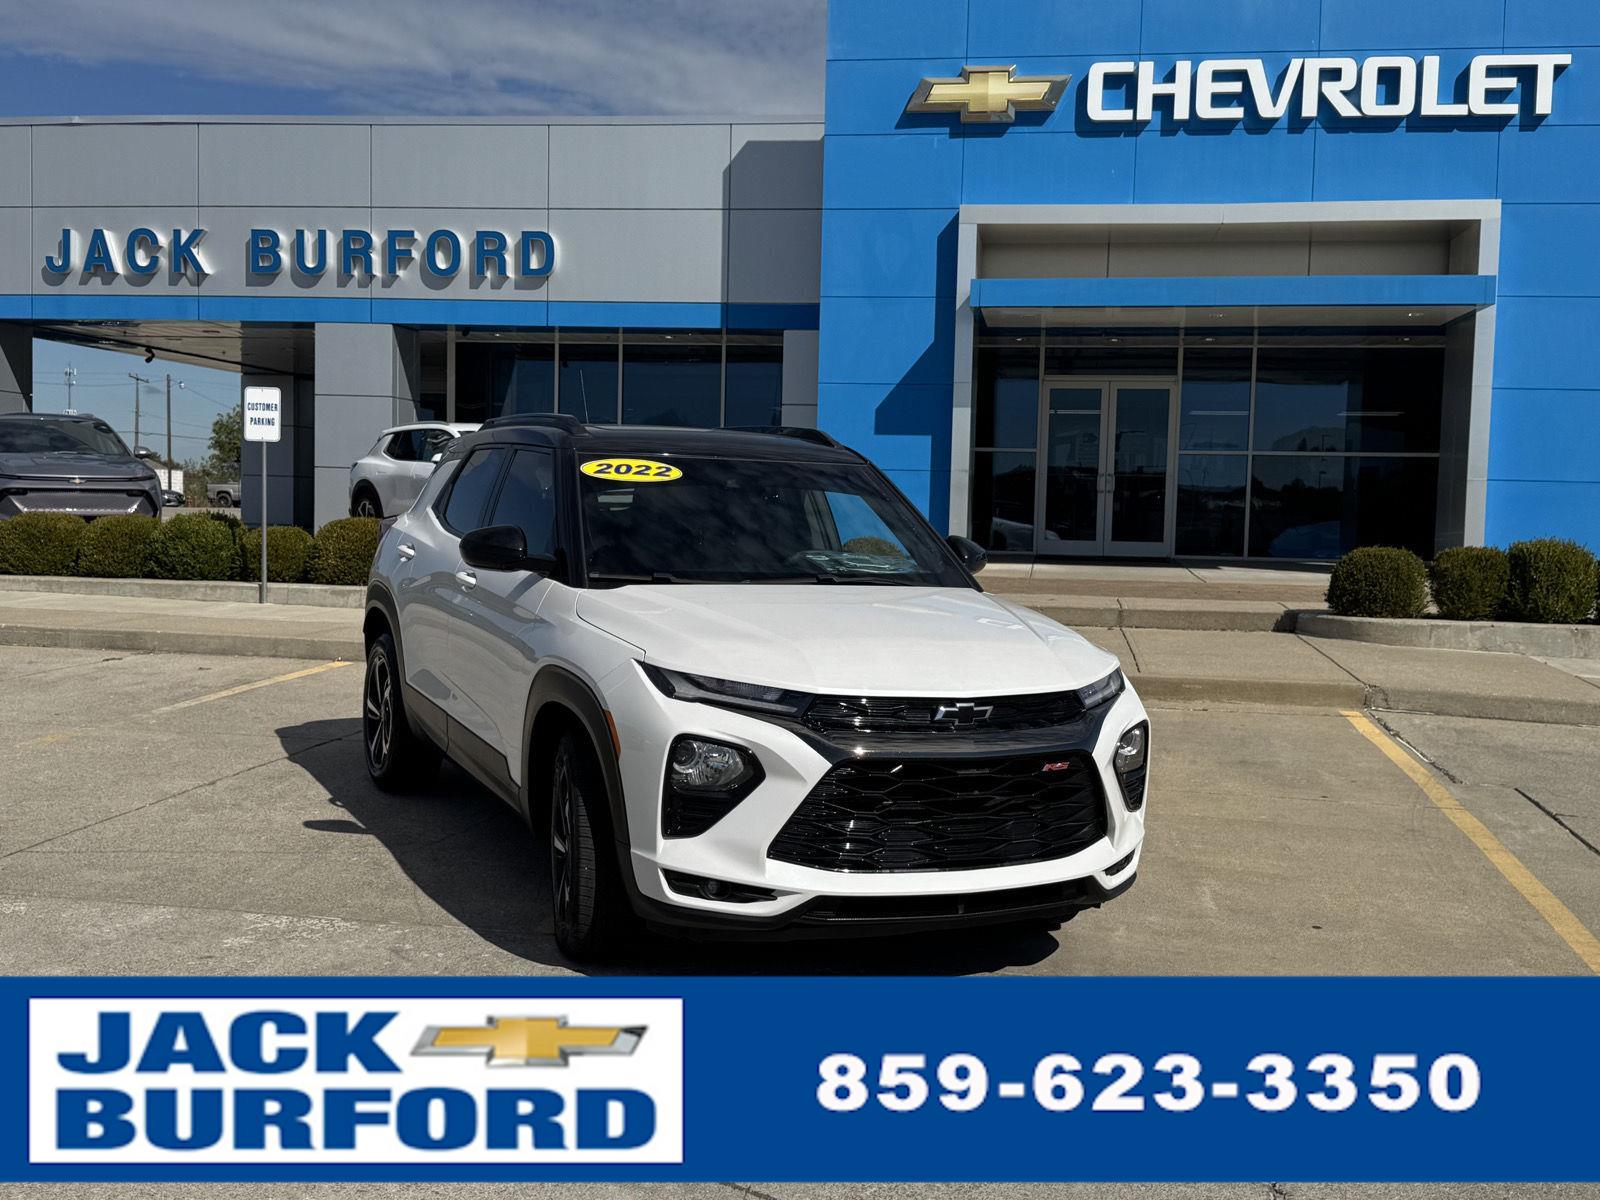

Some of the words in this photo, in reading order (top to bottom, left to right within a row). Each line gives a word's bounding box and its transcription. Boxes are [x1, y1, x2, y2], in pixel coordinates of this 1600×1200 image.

[1085, 53, 1572, 122] CHEVROLET
[45, 228, 212, 276] JACK
[250, 229, 556, 278] BURFORD
[247, 402, 278, 411] CUSTOMER
[250, 417, 275, 426] PARKING
[593, 463, 672, 477] 2022
[1041, 761, 1070, 772] RS
